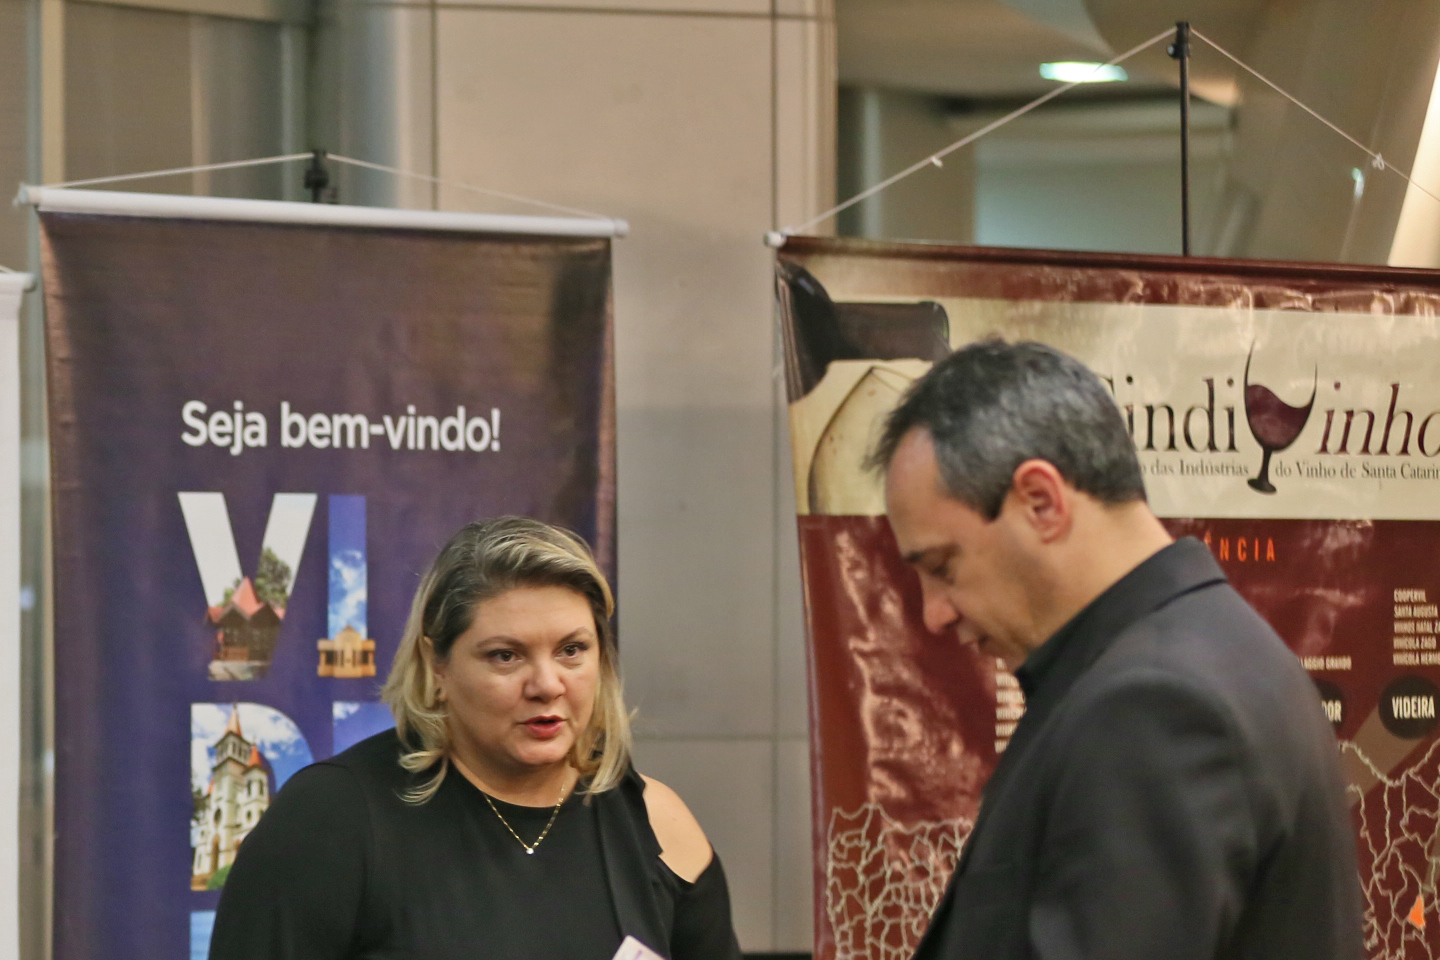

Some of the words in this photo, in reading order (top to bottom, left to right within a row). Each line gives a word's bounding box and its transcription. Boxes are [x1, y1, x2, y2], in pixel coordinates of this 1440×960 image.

[181, 400, 267, 455] Seja
[280, 401, 501, 451] bem-vindo!
[1151, 458, 1174, 475] das
[1275, 459, 1292, 476] do
[1296, 460, 1336, 478] Vinho
[1340, 461, 1356, 478] de
[1361, 461, 1396, 478] Santa
[1391, 695, 1435, 719] VIDEIRA
